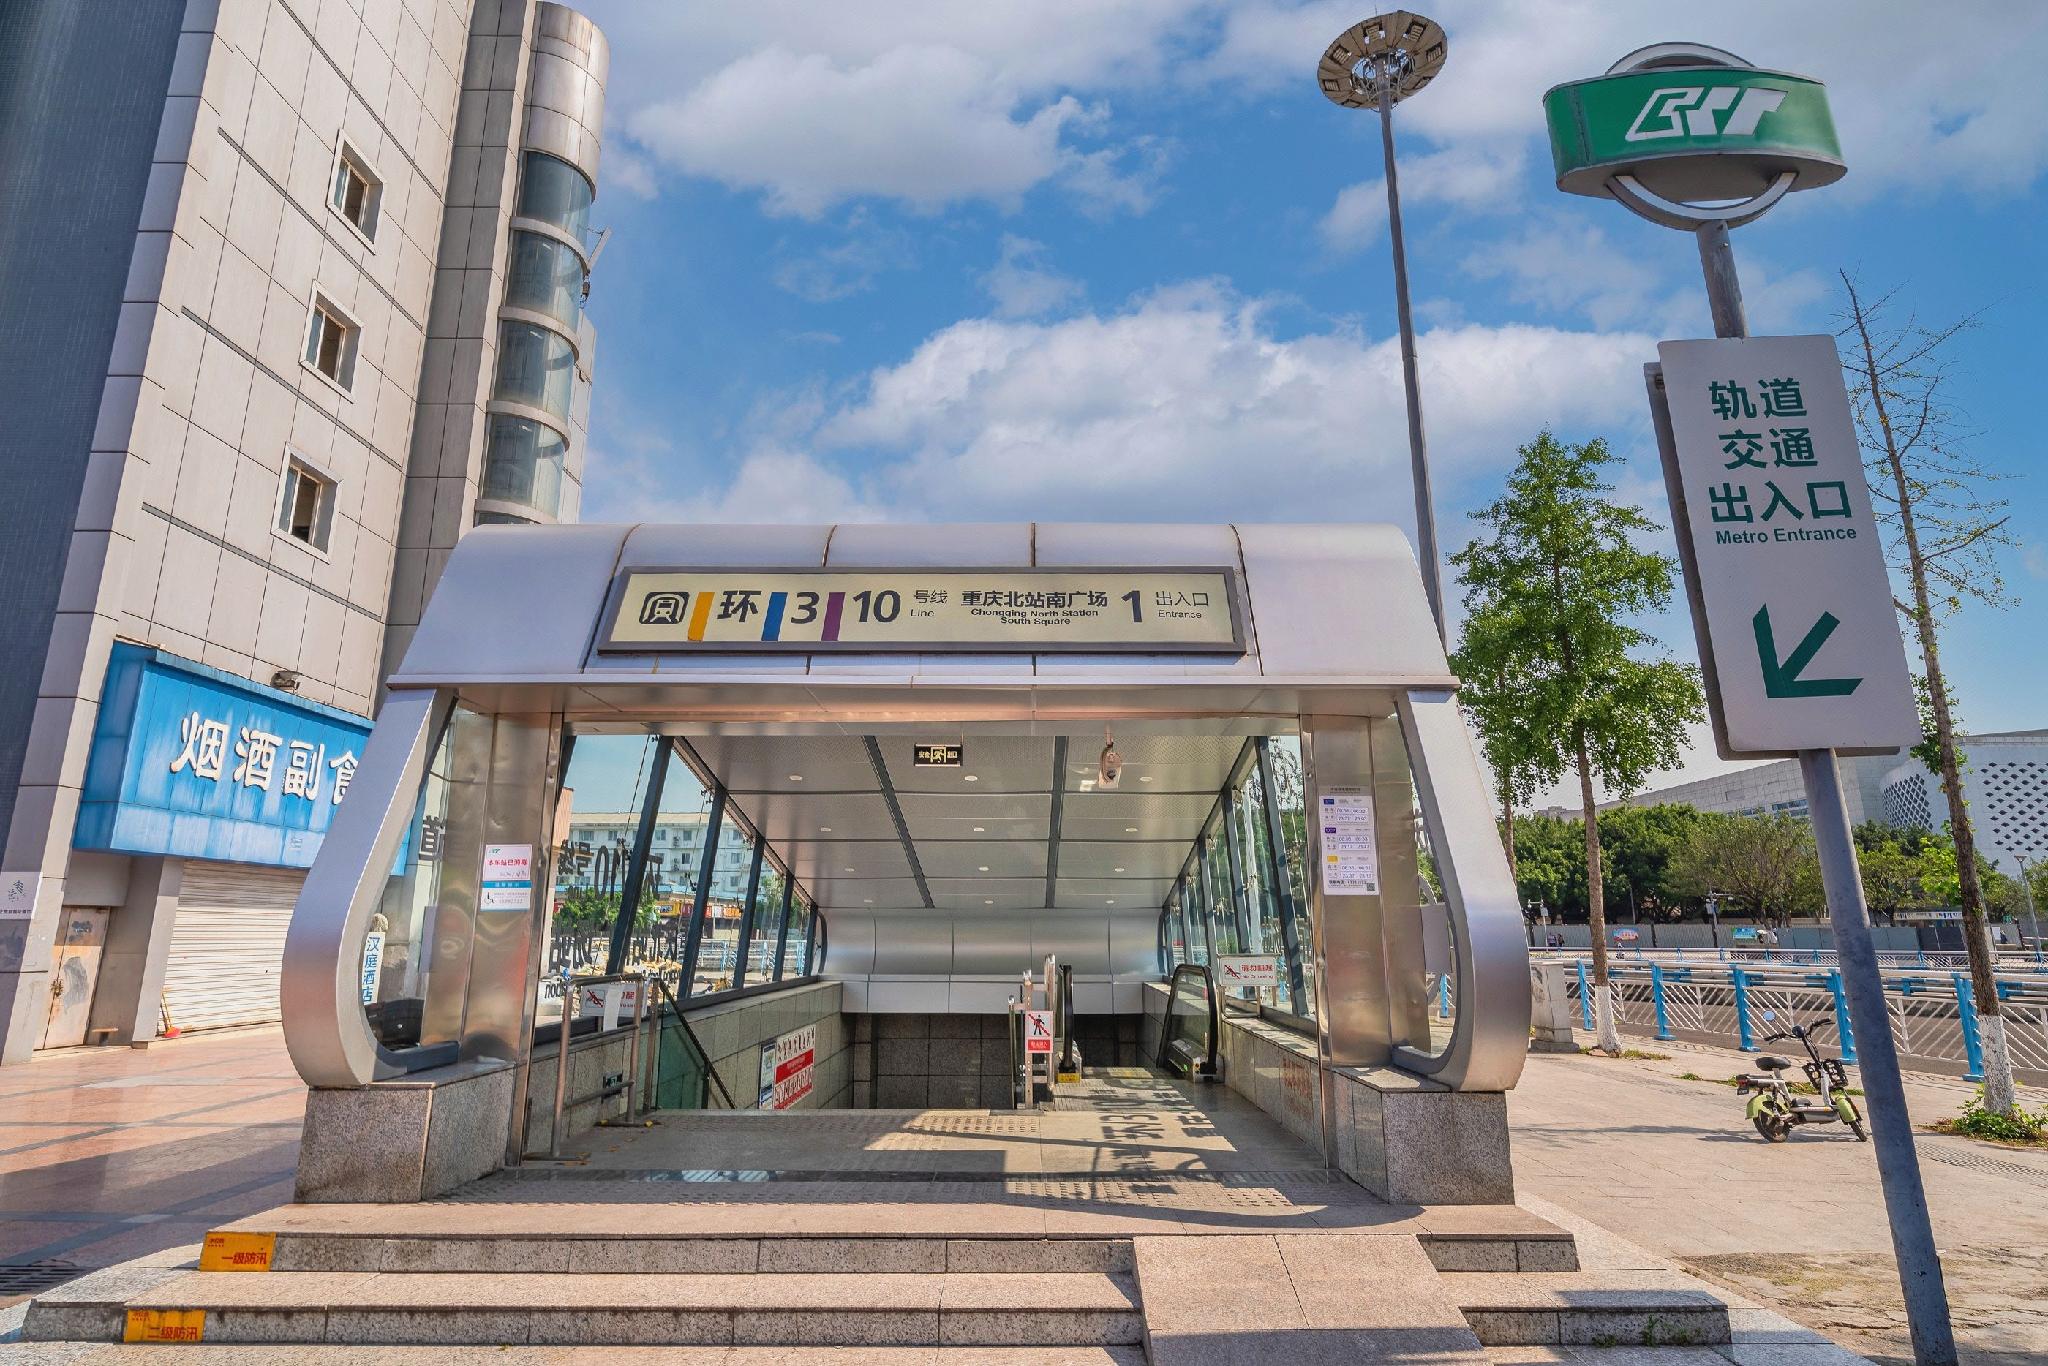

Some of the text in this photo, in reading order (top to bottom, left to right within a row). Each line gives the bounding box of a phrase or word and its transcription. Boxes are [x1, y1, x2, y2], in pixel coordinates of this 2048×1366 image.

[1709, 377, 1807, 421] 轨道
[1718, 428, 1818, 470] 交通
[1709, 480, 1853, 523] 出入口
[1716, 528, 1857, 544] Metro Entrance
[717, 589, 948, 624] 环 3 10 号线
[960, 590, 1108, 609] 重庆北站南广场
[1121, 590, 1209, 623] 1 出入口
[910, 608, 935, 617] Line
[970, 608, 1099, 618] Chongqing North Station
[1158, 610, 1202, 619] Entrance
[1000, 616, 1071, 627] South Square
[221, 1251, 267, 1265] 一级防汛
[147, 1326, 198, 1340] 二级防汛
